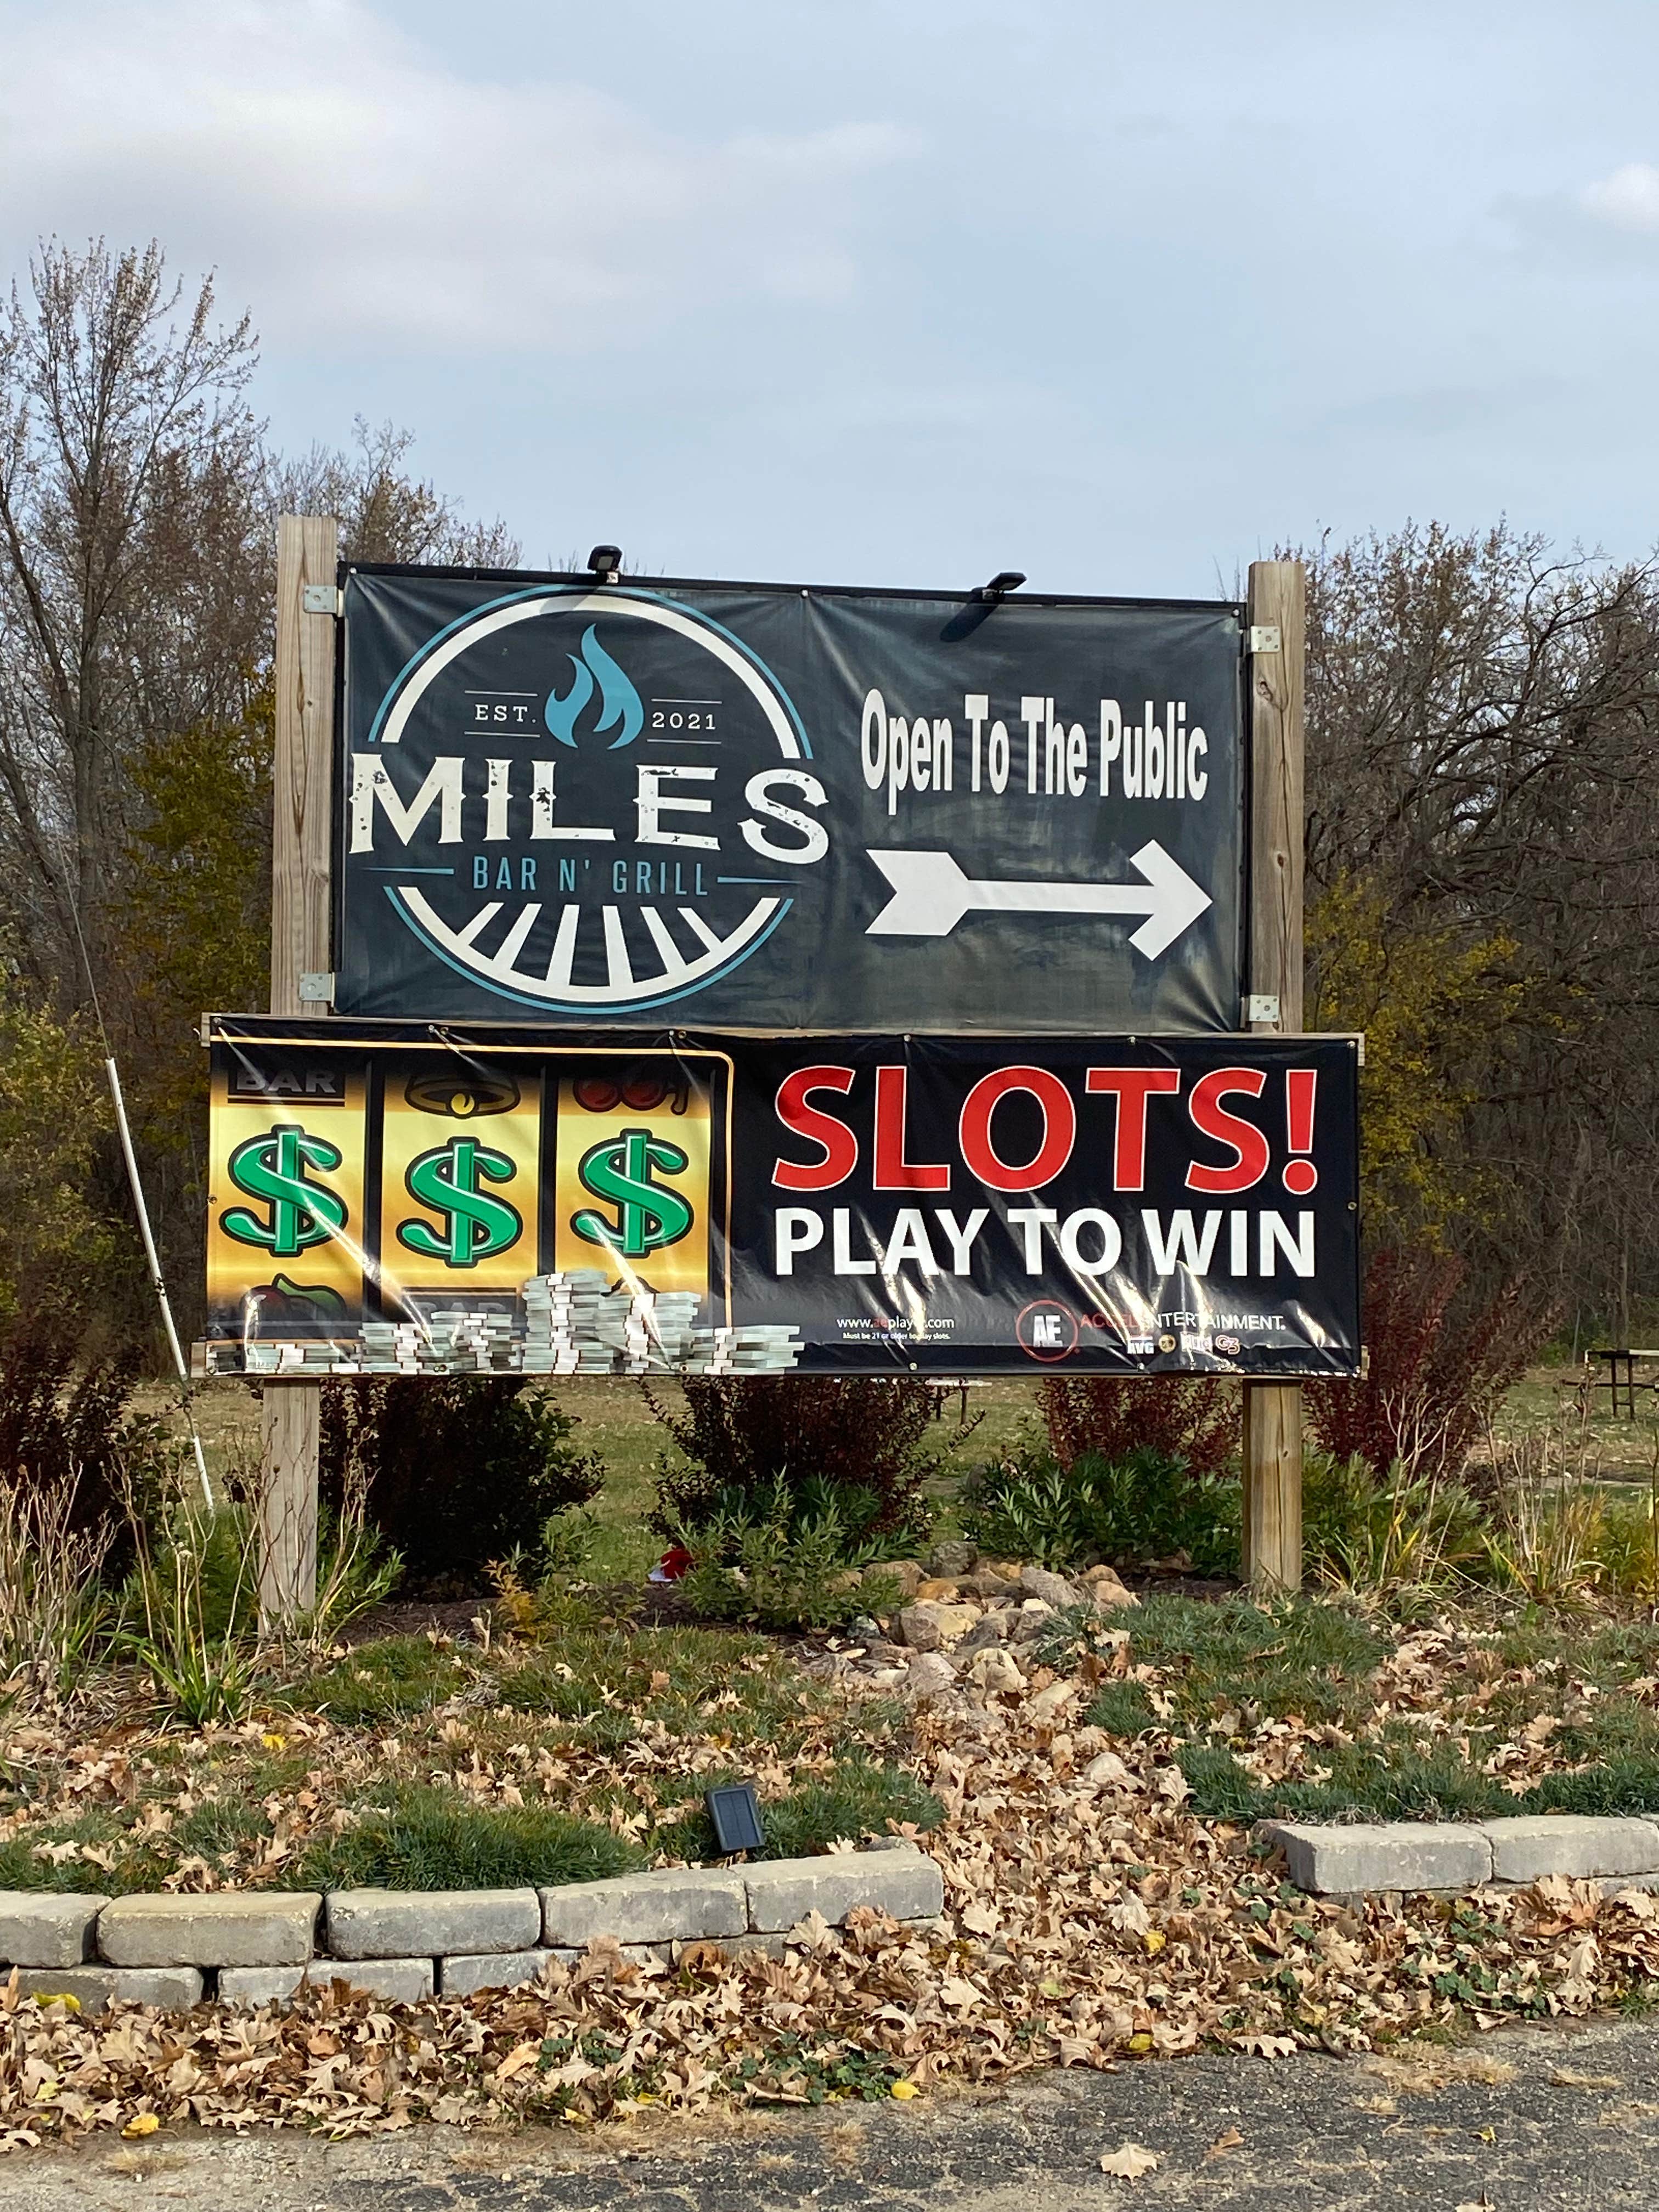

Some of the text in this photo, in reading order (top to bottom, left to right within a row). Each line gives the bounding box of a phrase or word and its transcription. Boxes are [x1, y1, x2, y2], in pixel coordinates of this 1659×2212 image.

[475, 703, 716, 730] EST. 2021
[861, 688, 1208, 816] Open To The Public
[349, 753, 830, 864] MILES
[472, 856, 708, 896] BAR N' GRILL
[236, 1066, 337, 1093] BAR
[771, 1064, 1318, 1195] SLOTS!
[775, 1207, 1316, 1278] PLAY TO WIN
[836, 1314, 955, 1331] www.aeplay.com
[890, 1332, 908, 1340] older
[1033, 1314, 1063, 1348] AE
